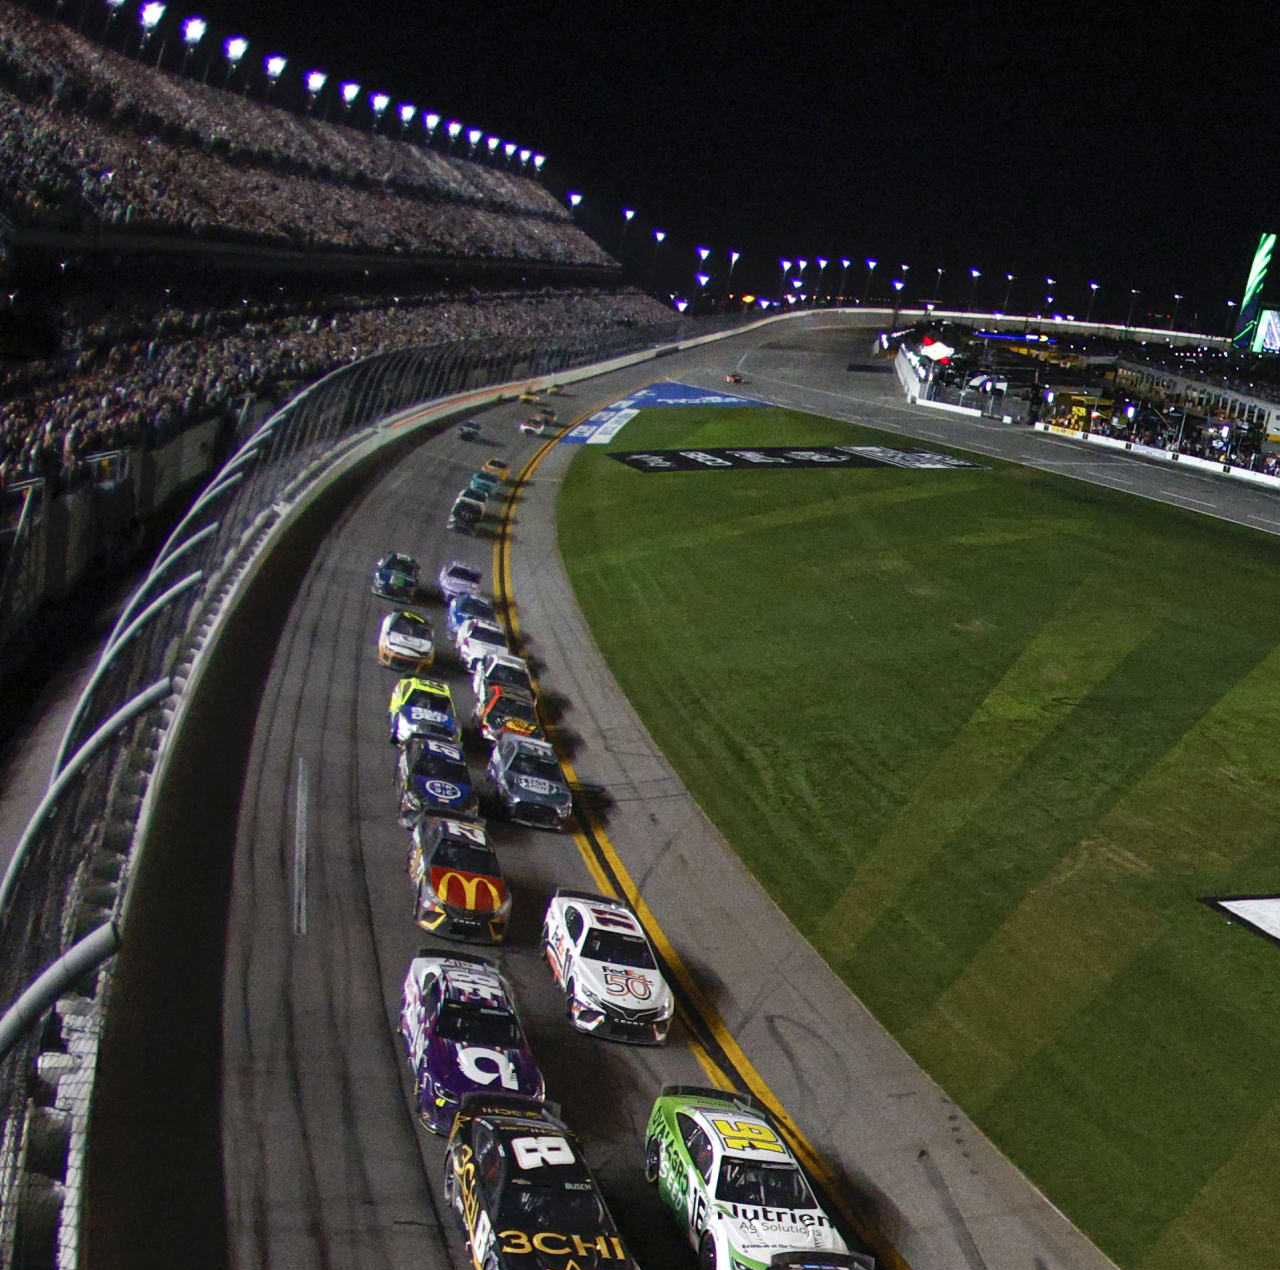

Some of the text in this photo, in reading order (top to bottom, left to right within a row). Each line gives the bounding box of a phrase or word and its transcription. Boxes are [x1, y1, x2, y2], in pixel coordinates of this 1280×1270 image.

[604, 974, 651, 1000] 50
[511, 1136, 576, 1170] 8
[473, 1209, 492, 1264] 8
[739, 1221, 759, 1234] Ag
[498, 1230, 628, 1261] 3CHI
